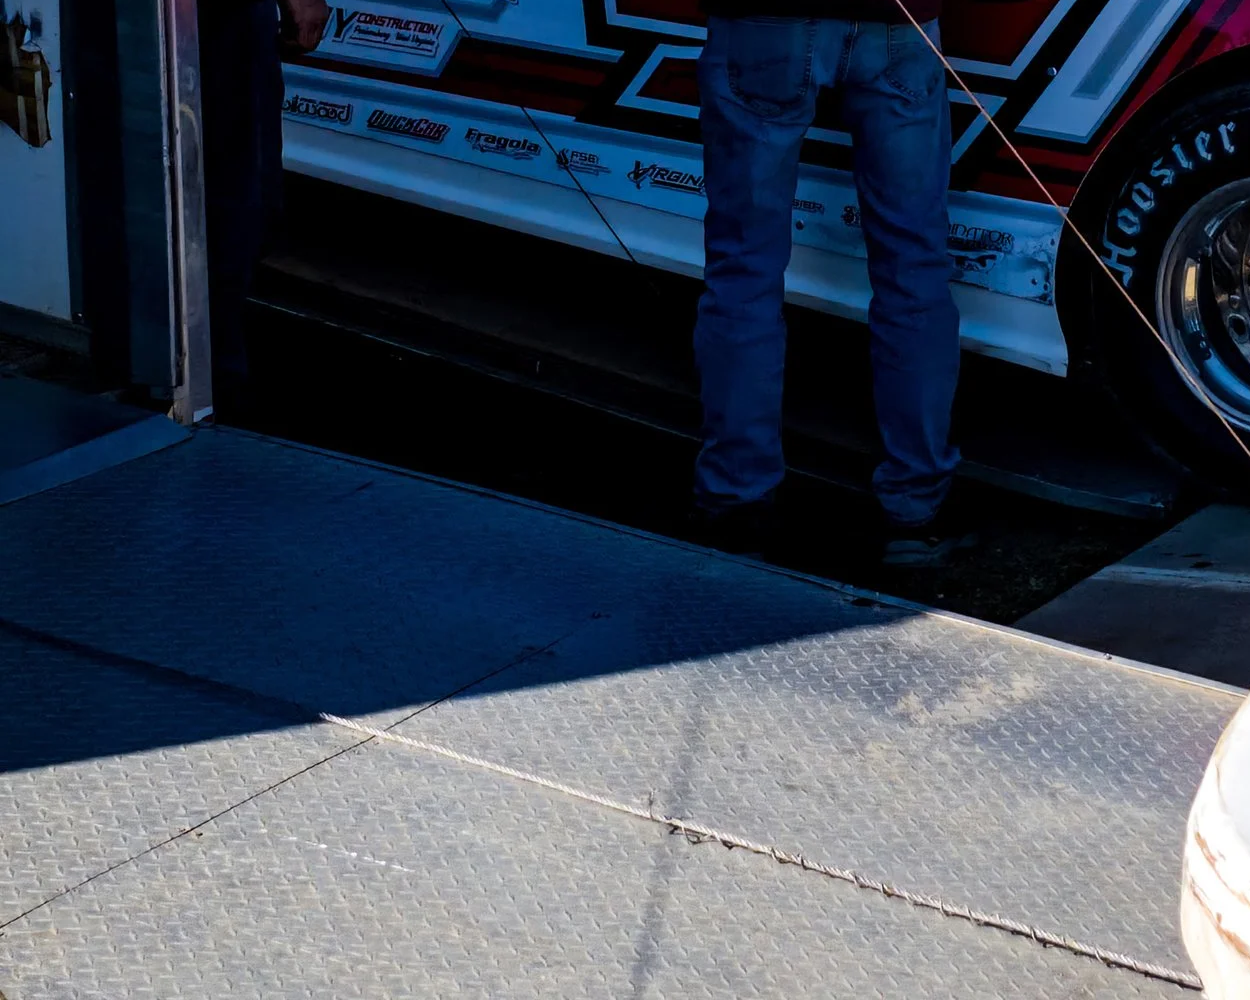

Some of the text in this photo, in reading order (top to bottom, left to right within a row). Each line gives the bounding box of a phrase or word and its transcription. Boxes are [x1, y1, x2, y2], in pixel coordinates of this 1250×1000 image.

[356, 12, 439, 35] CONSTRUCTION
[464, 127, 540, 153] Fragola
[626, 160, 705, 190] VIRGIN
[1100, 120, 1237, 289] Hoosier
